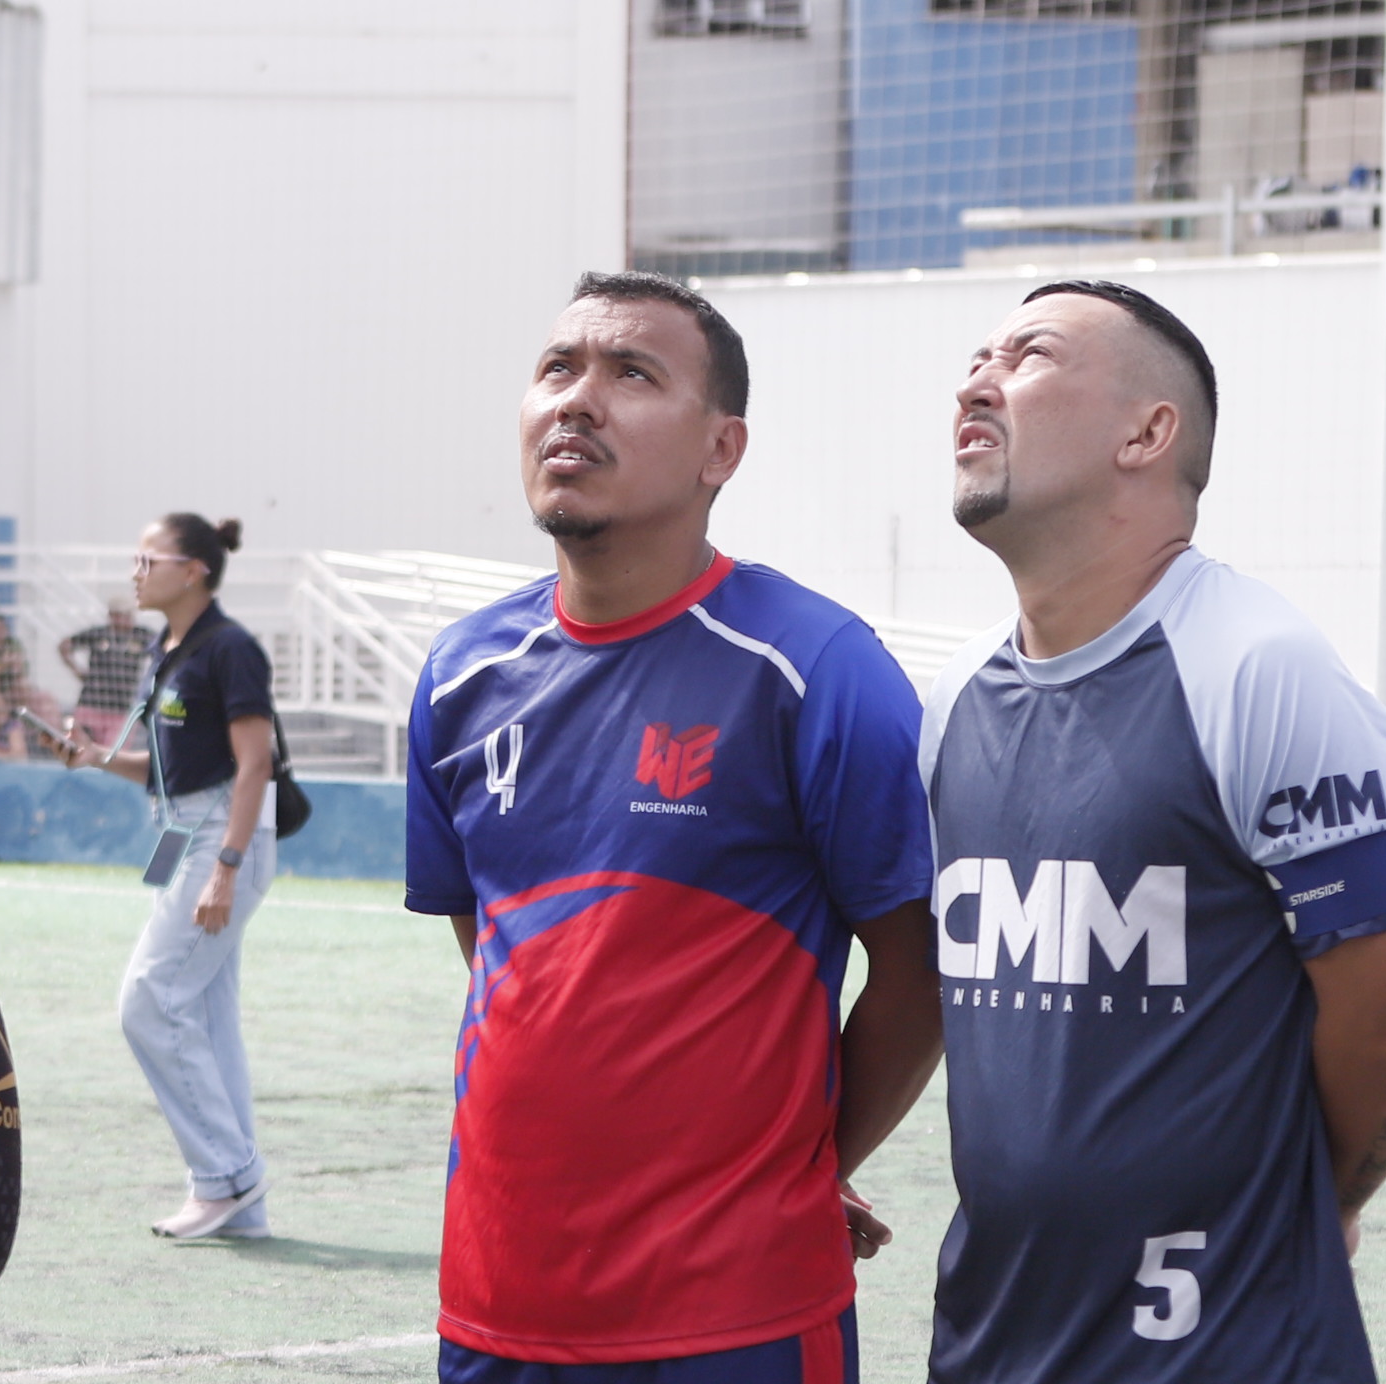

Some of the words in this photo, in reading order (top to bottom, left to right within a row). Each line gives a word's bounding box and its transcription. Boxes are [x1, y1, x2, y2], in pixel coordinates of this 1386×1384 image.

[484, 724, 524, 816] 4
[635, 721, 720, 801] WE
[629, 801, 708, 816] ENGENHARIA
[938, 857, 1188, 986] CMM
[1288, 880, 1346, 907] STARSIDE
[940, 987, 1186, 1015] NGENHARIA
[1132, 1231, 1207, 1341] 5
